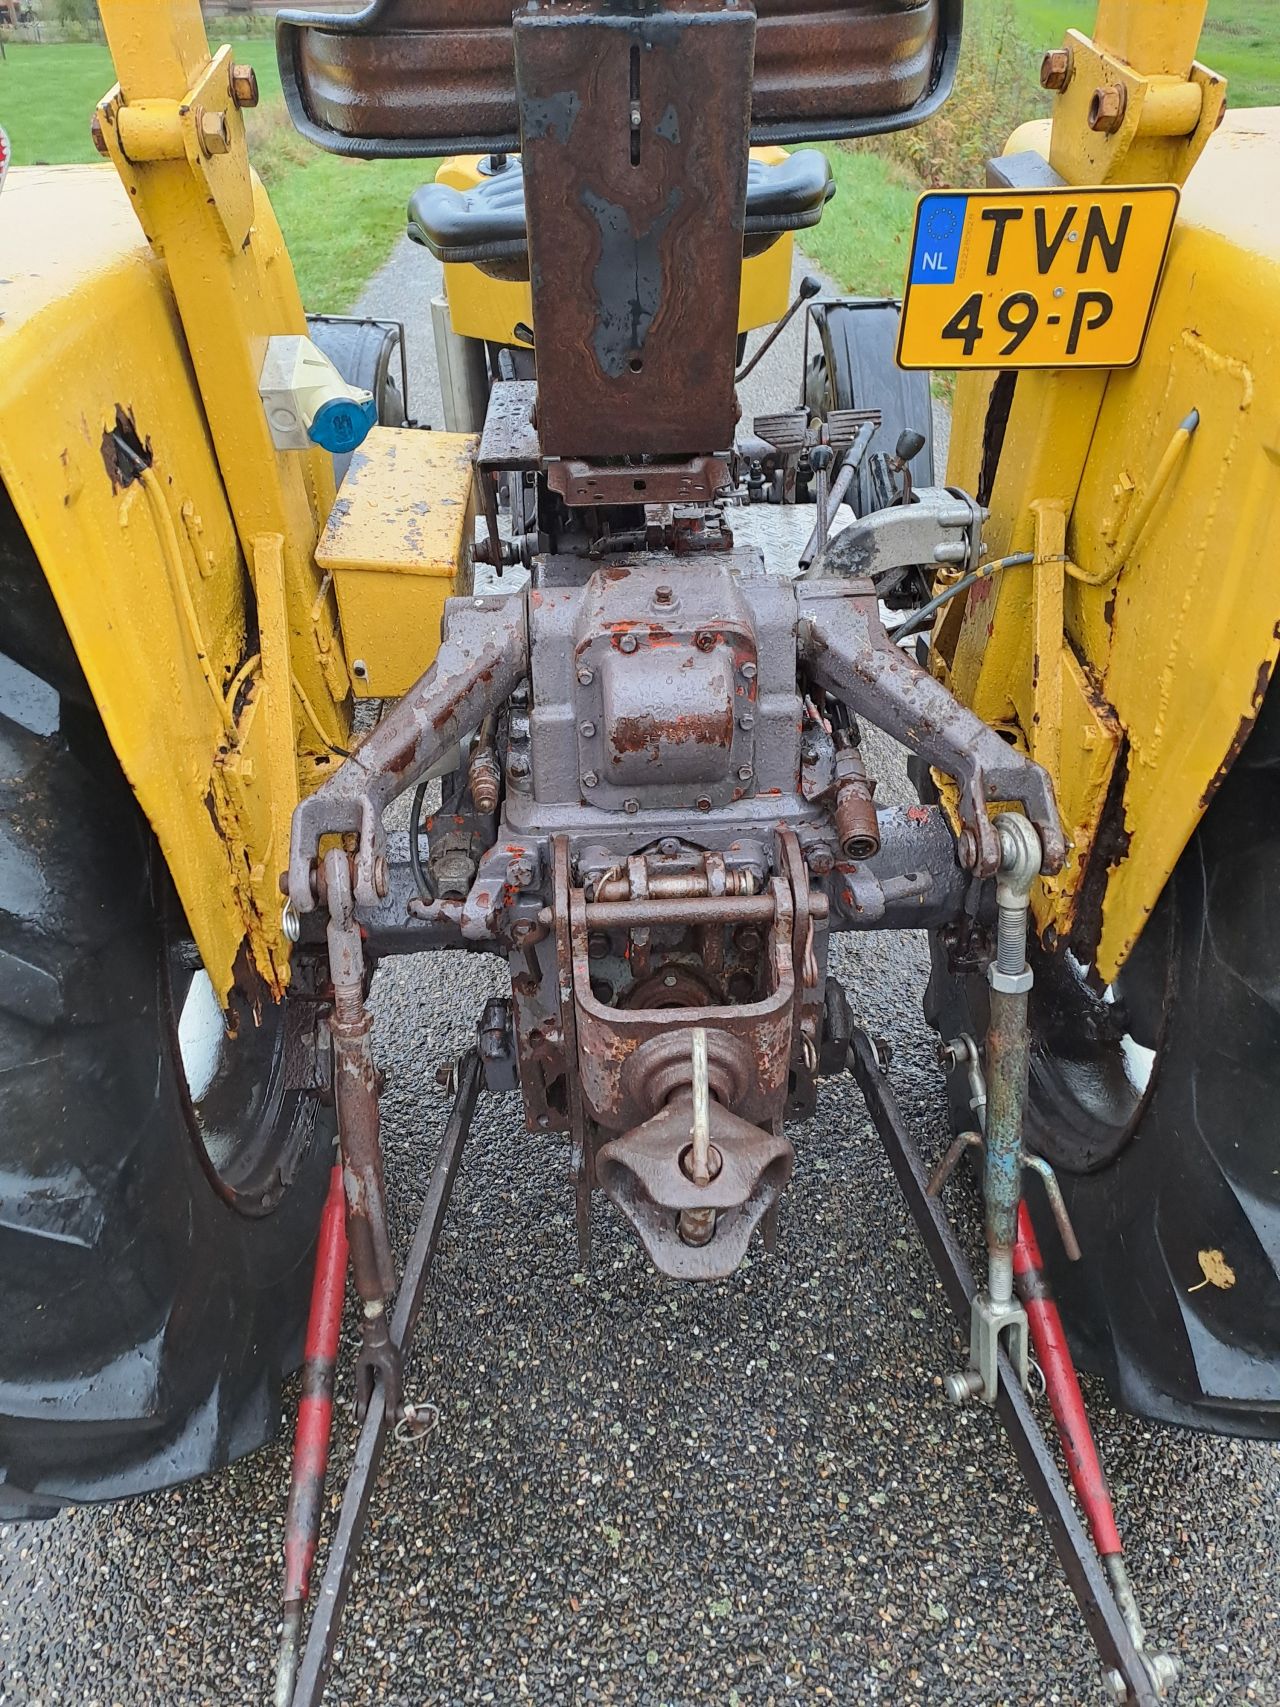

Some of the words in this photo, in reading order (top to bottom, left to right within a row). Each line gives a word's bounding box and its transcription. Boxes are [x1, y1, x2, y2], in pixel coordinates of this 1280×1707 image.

[922, 252, 948, 270] NL
[981, 206, 1133, 276] TVN
[941, 292, 1114, 356] 49-P
